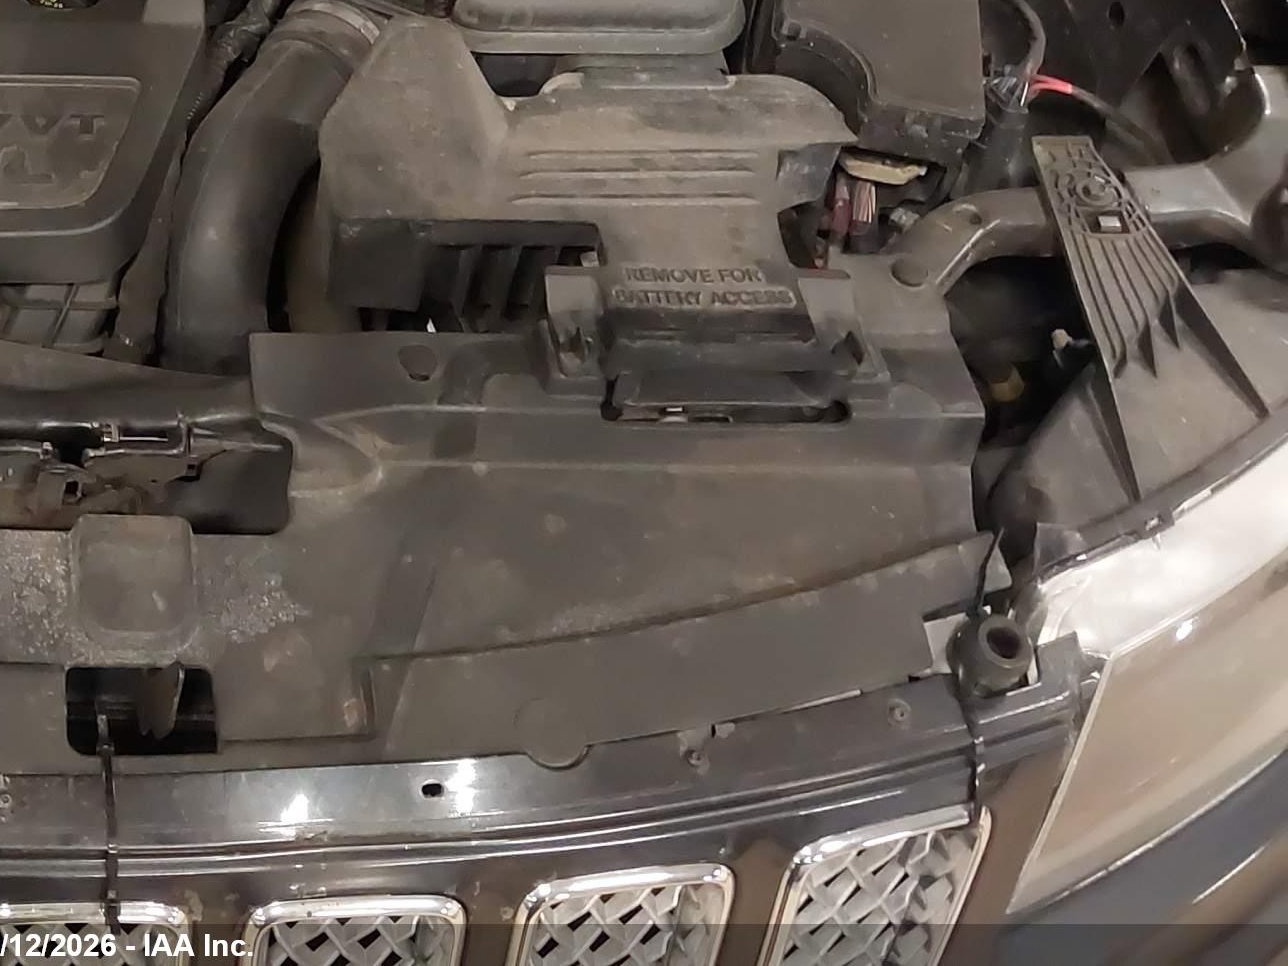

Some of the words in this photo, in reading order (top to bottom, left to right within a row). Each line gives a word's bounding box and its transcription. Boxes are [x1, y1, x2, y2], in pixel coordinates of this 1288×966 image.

[624, 267, 714, 284] REMOVE
[717, 267, 763, 284] FOR
[614, 289, 702, 306] BATTERY
[711, 289, 794, 307] ACCESS
